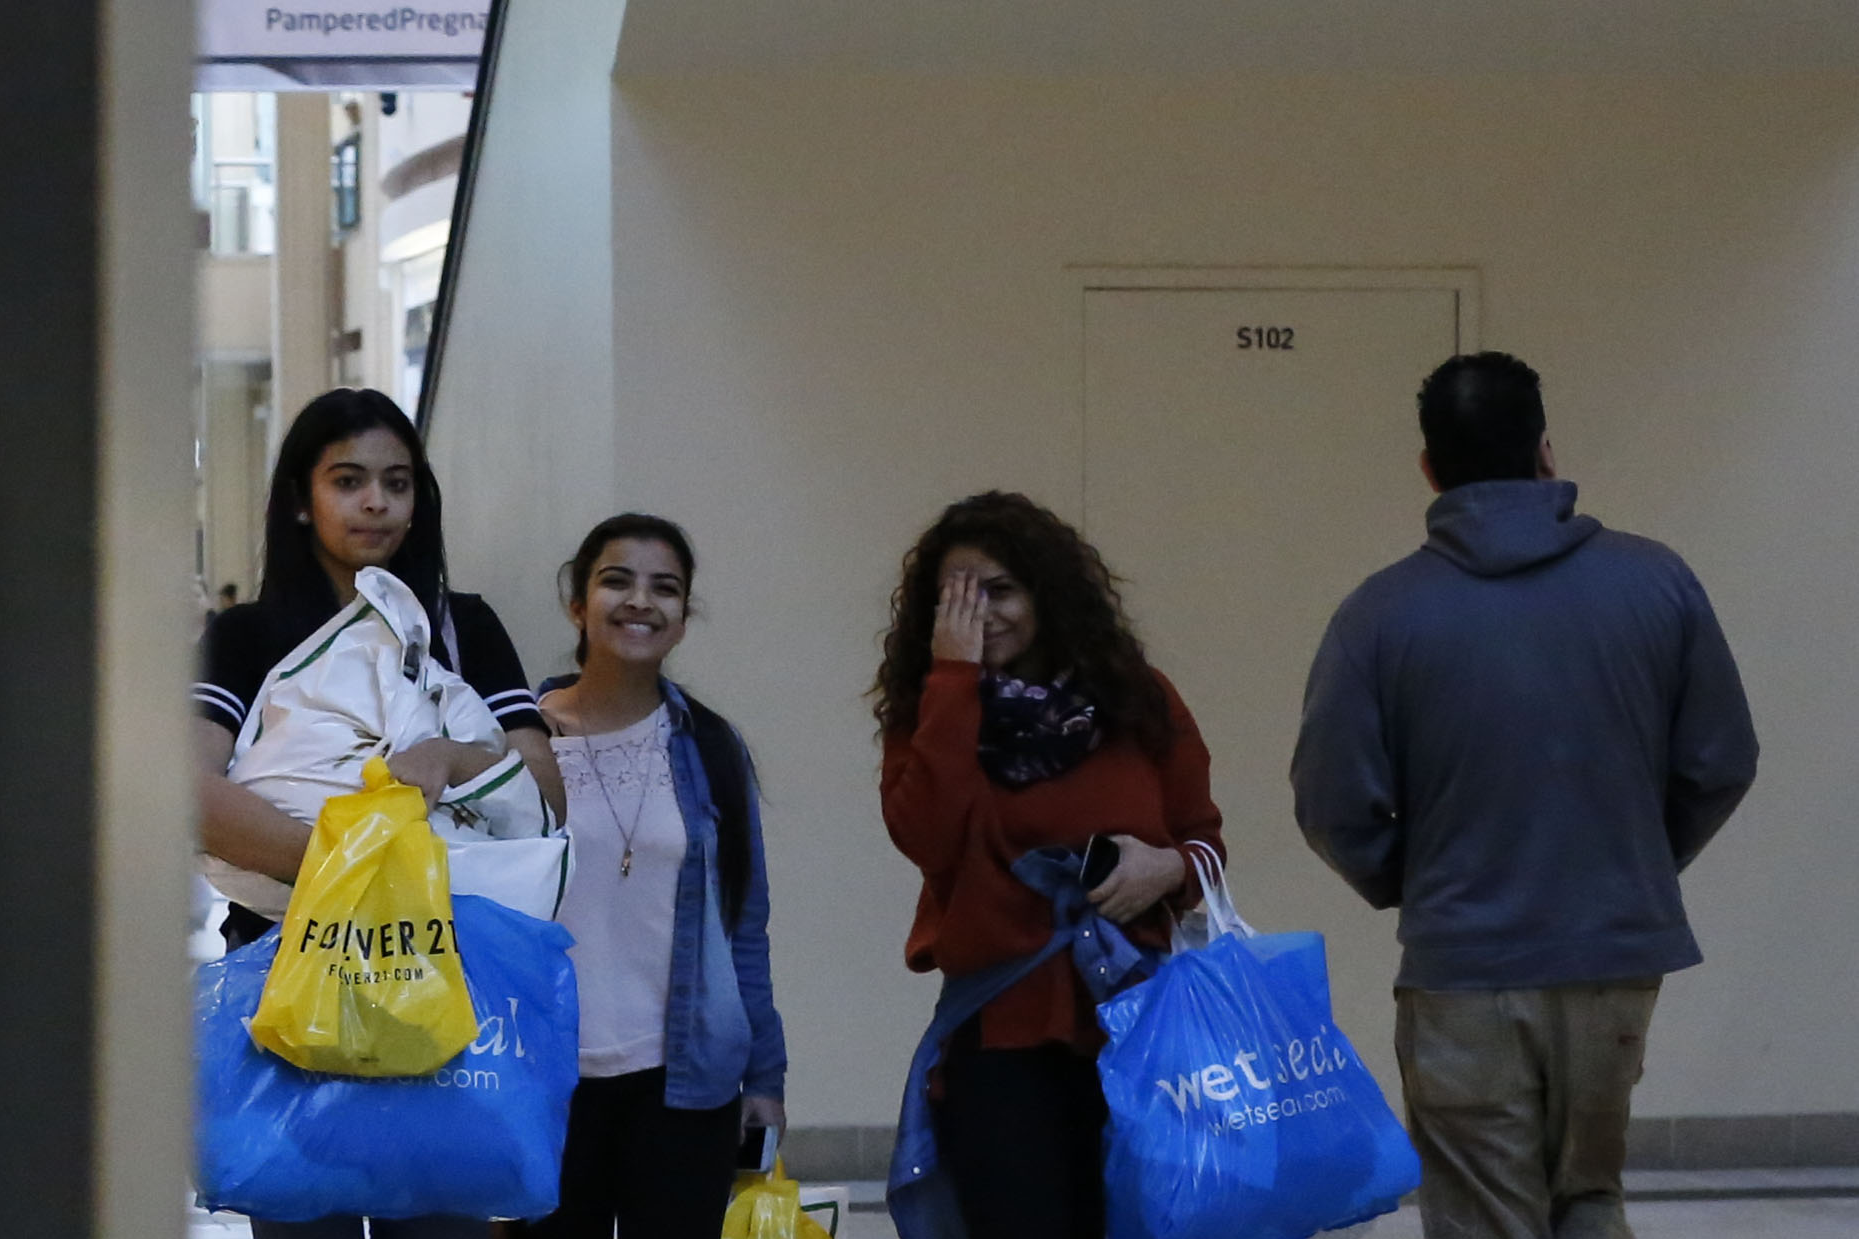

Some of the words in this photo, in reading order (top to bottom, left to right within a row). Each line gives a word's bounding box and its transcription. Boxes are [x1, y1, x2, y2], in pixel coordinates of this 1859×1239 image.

[1237, 326, 1294, 350] S102
[300, 918, 417, 961] FOVER
[469, 997, 525, 1058] al
[1156, 1048, 1271, 1114] wet
[1207, 1086, 1348, 1137] wetsealcom
